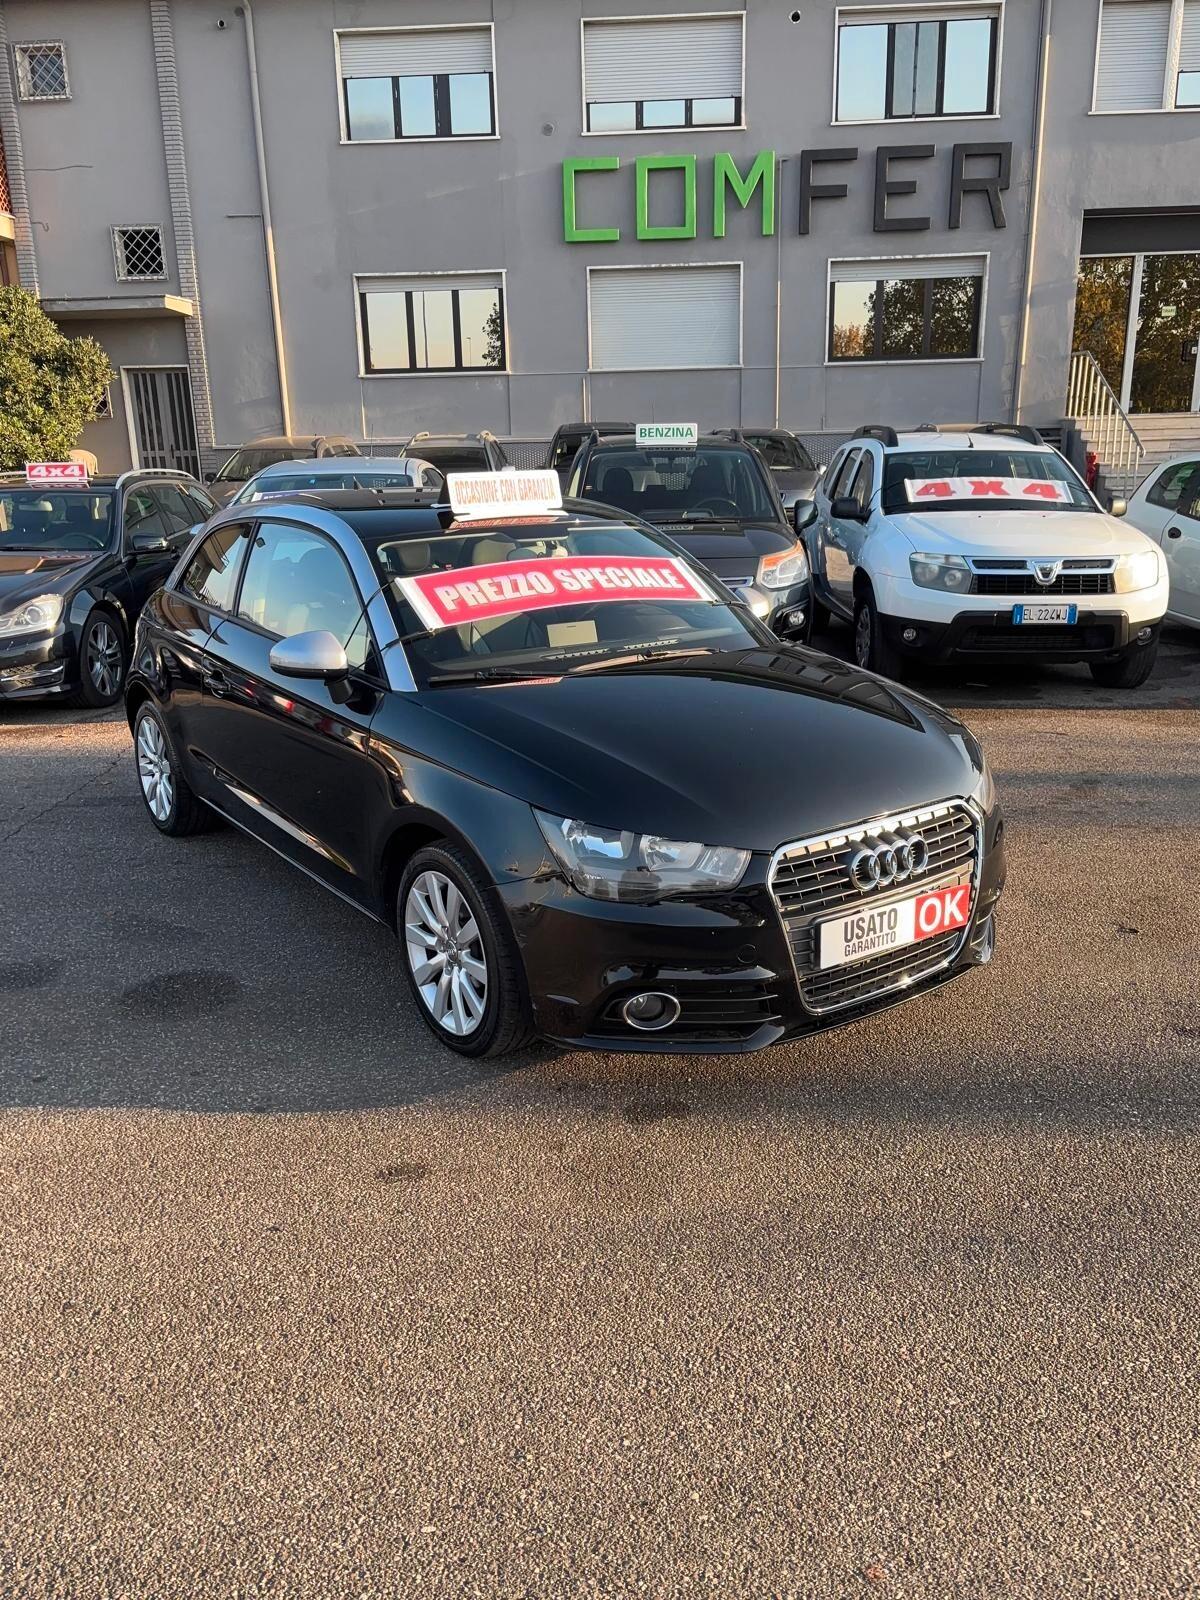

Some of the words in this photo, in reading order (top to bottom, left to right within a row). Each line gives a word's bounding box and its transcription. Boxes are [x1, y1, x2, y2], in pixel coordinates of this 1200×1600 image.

[562, 142, 1012, 243] COMFER
[640, 428, 693, 439] BENZINA
[31, 466, 82, 477] 4x4
[454, 480, 499, 506] OCCASIONE
[501, 478, 517, 503] CON
[518, 477, 556, 502] GARANZIA
[916, 482, 957, 497] 4
[1023, 482, 1063, 500] 4
[433, 571, 556, 611] PREZZO
[553, 566, 686, 591] SPECIALE
[1023, 608, 1034, 621] EL
[1038, 608, 1068, 621] 224WJ
[844, 907, 898, 945] USATO
[919, 890, 965, 932] OK
[844, 931, 897, 958] GARANTITO
